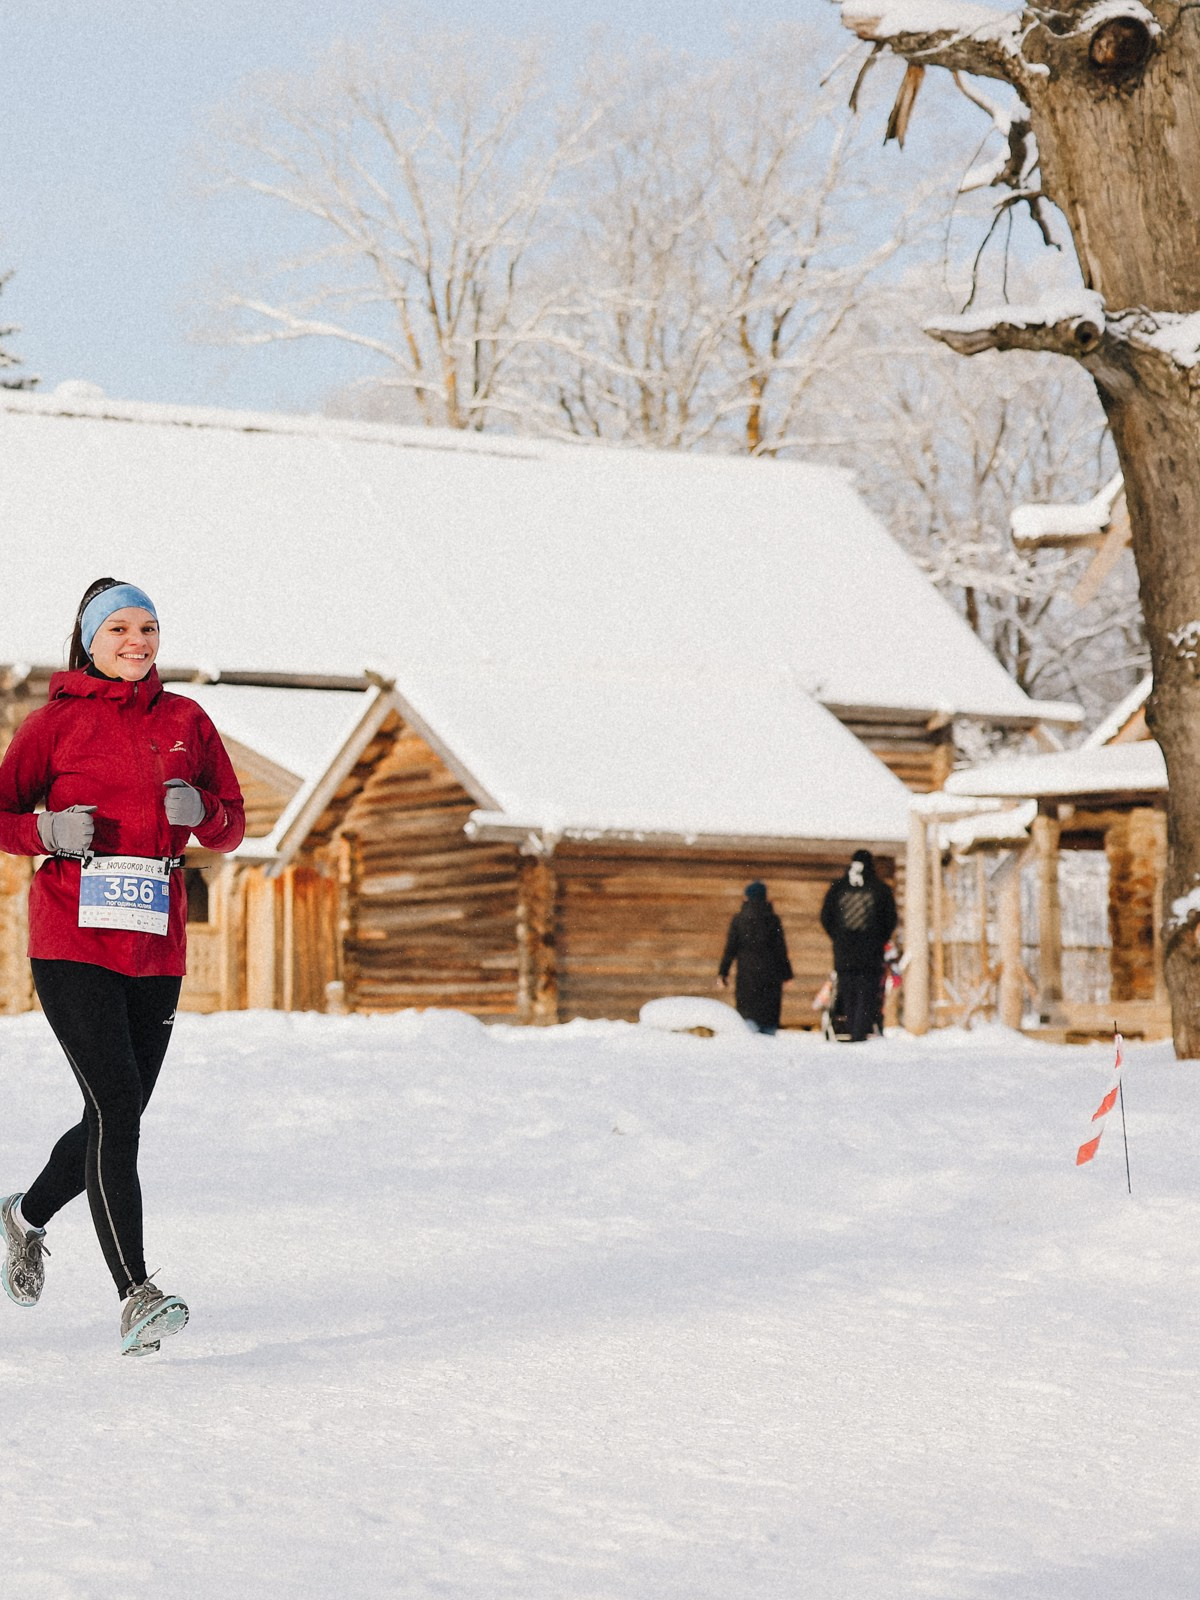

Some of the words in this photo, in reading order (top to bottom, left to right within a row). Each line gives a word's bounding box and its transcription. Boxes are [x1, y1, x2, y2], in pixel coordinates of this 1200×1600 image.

[106, 862, 143, 871] NOVGOROD
[144, 864, 155, 874] ICE
[104, 878, 154, 904] 356
